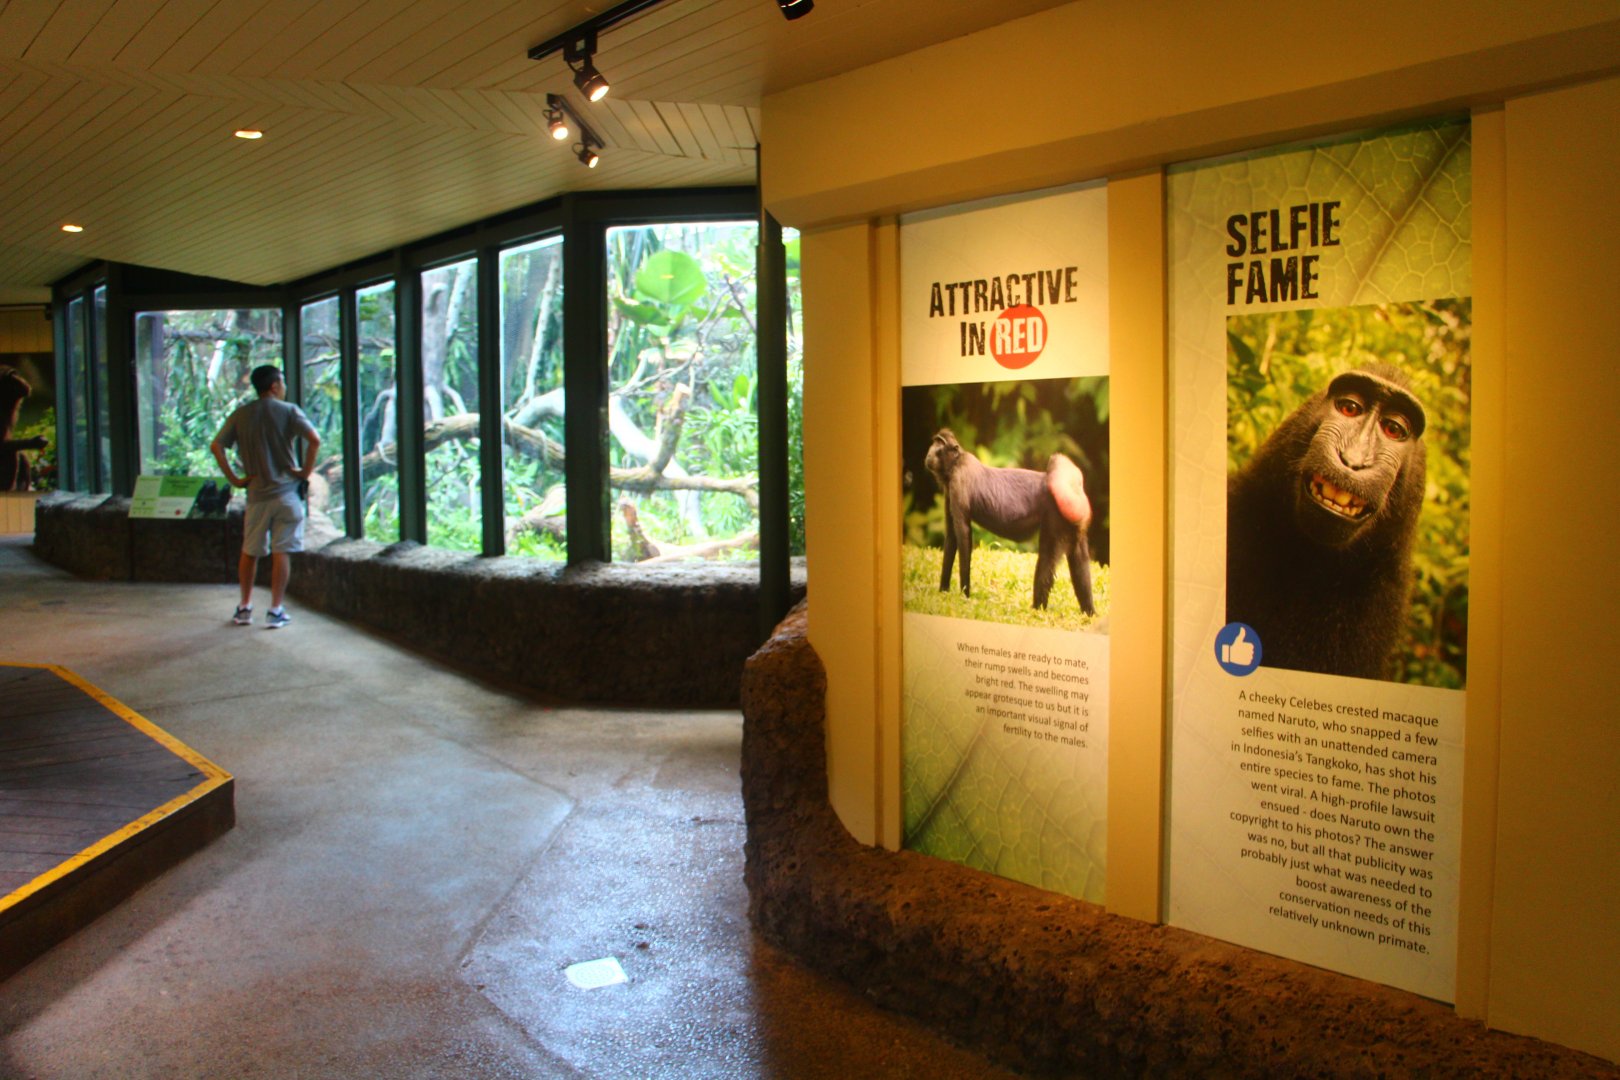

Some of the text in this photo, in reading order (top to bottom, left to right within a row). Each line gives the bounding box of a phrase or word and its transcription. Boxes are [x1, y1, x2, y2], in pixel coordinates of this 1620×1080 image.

[1226, 201, 1341, 257] SELFIE
[929, 266, 1078, 318] ATTRACTIVE
[1227, 255, 1319, 305] FAME
[960, 317, 1044, 357] IN RED
[957, 642, 979, 653] When
[981, 645, 1011, 658] females
[1029, 653, 1050, 664] ready
[1054, 656, 1062, 665] to
[1065, 658, 1088, 670] mate,
[965, 659, 1088, 685] their rump swells and becomes
[965, 688, 1088, 716] appear grotesque to us but it is
[976, 675, 1088, 702] bright red. The swelling may
[1239, 691, 1439, 727] A cheeky Celebes crested macaque
[987, 707, 1025, 720] important
[1028, 714, 1050, 725] visual
[1053, 718, 1077, 730] signal
[1080, 723, 1088, 732] of
[1004, 724, 1088, 748] fertility to the males.
[1238, 708, 1438, 746] named Naruto, who snapped a few
[1231, 742, 1240, 752] in
[1306, 754, 1361, 773] Tangkoko,
[1365, 763, 1385, 776] has
[1389, 768, 1415, 781] shot
[1419, 772, 1437, 785] his
[1241, 726, 1437, 765] selfies with an unattended camera
[1240, 761, 1436, 804] entire species to fame. The photos
[1251, 782, 1435, 823] went viral. A high-profile lawsuit
[1230, 811, 1434, 861] copyright to his photos? The answer
[1261, 800, 1300, 815] ensued
[1310, 808, 1336, 822] does
[1340, 814, 1381, 832] Naruto
[1384, 824, 1409, 837] own
[1414, 827, 1434, 842] the
[1241, 847, 1432, 898] probably just what was needed to
[1248, 832, 1433, 880] was no, but all that publicity was
[1279, 891, 1431, 936] conservation needs of this
[1296, 875, 1431, 917] boost awareness of the
[1269, 905, 1429, 954] relatively unknown primate.
